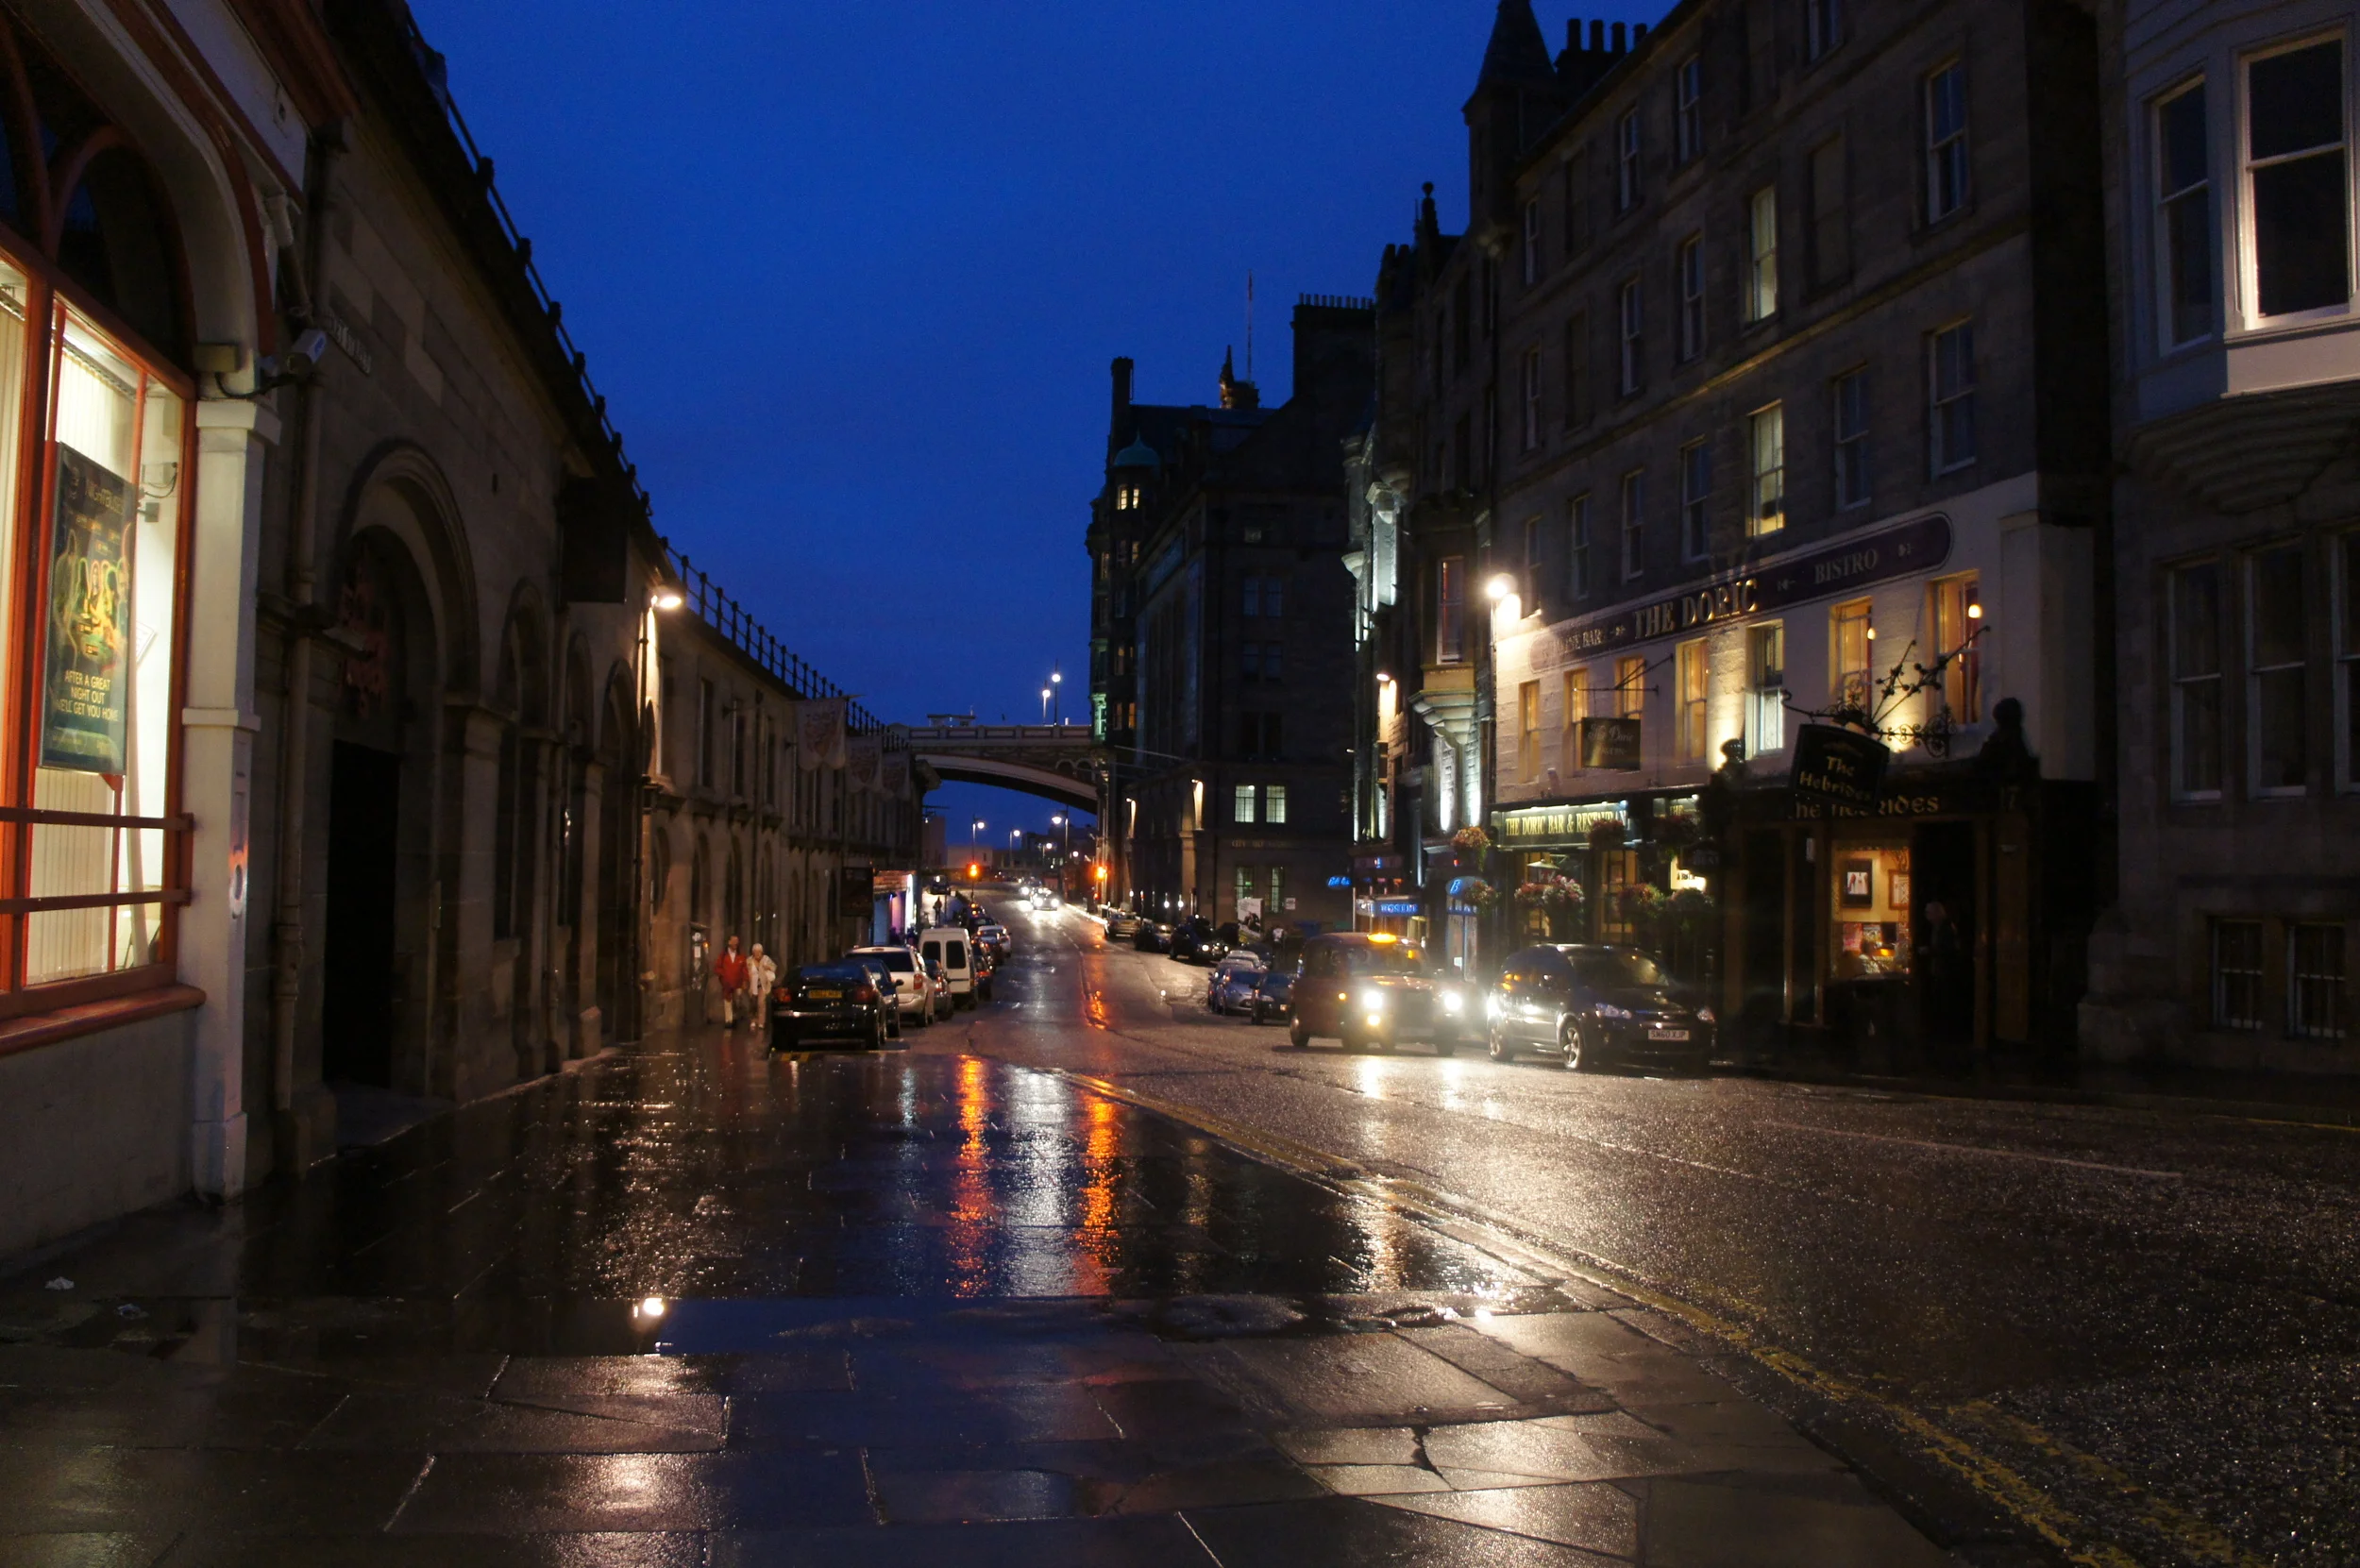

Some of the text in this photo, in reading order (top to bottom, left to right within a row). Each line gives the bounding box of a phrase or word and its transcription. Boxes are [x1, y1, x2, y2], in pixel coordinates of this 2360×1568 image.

[1582, 629, 1602, 649] BAR
[1634, 601, 1677, 639] THE
[1682, 578, 1759, 628] DORIC
[1814, 548, 1879, 584] BISTRO
[64, 670, 111, 691] AFTER A GREAT
[71, 686, 106, 705] NIGHT OUT
[75, 701, 86, 716] GET
[87, 704, 101, 717] YOU
[102, 707, 119, 721] HOME
[1827, 755, 1855, 777] The
[1799, 770, 1871, 801] Hebrides
[1787, 801, 1820, 819] he
[1506, 818, 1520, 836] THE
[1522, 816, 1545, 835] DORIC
[1548, 814, 1564, 834] BAR
[1567, 814, 1575, 833] &
